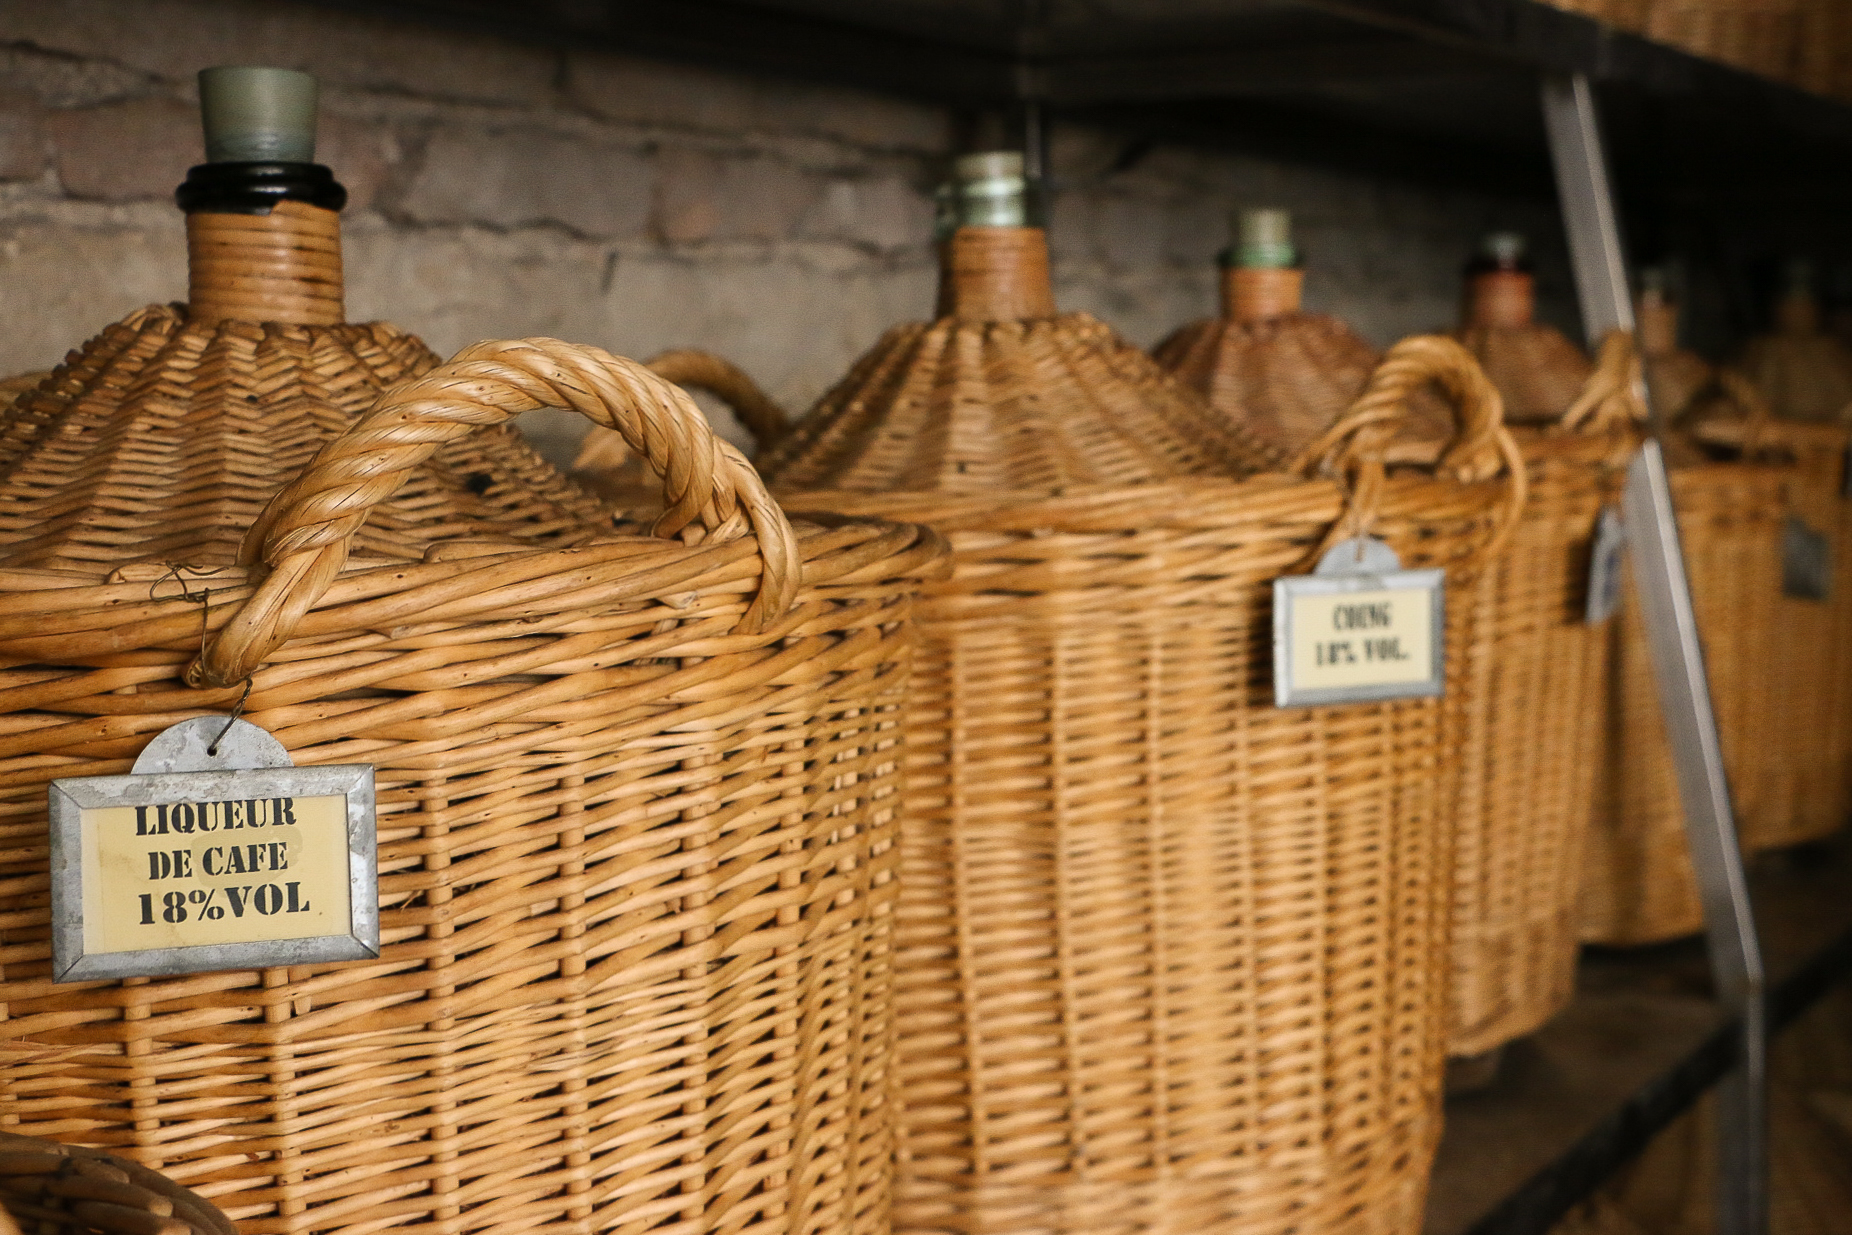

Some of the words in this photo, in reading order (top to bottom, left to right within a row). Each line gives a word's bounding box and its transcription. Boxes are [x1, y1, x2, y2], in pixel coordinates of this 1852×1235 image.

[134, 797, 297, 836] LIQUEUR
[147, 849, 193, 880] DE
[202, 841, 288, 876] CAFE
